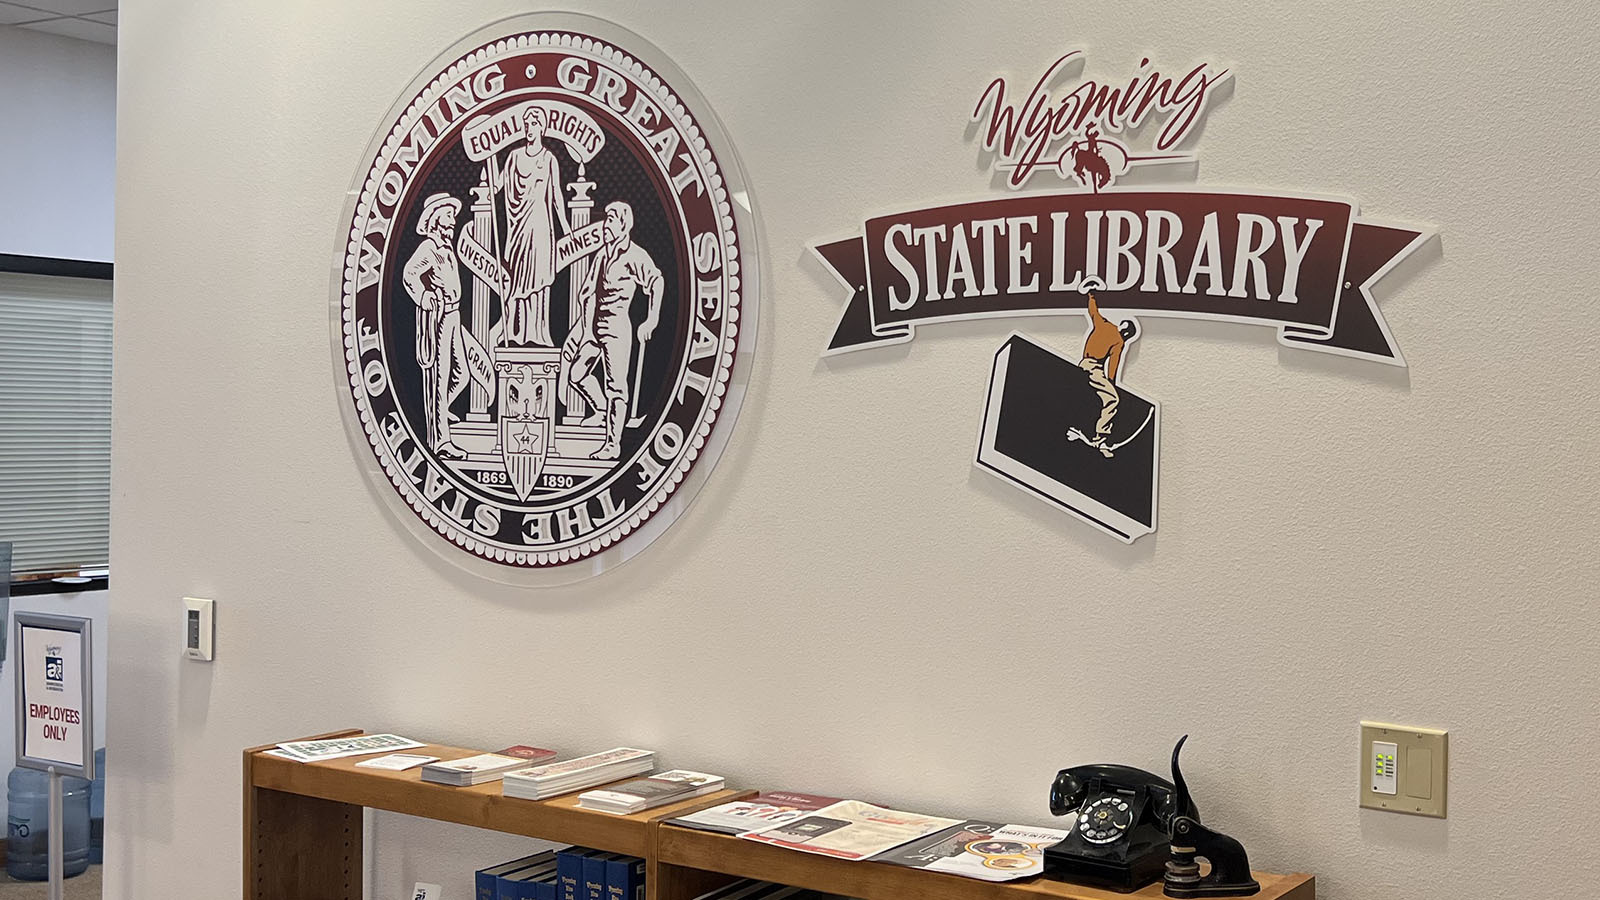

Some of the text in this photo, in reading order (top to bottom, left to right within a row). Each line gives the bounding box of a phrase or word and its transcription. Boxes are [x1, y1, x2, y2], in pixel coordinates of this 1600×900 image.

[974, 50, 1229, 183] Wyoming
[470, 111, 602, 155] EQUAL RIGHTS
[559, 228, 600, 260] MINES
[884, 209, 1324, 311] STATE LIBRARY
[357, 57, 722, 544] GREAT SEAL OF THE STATE OF WYOMING
[468, 346, 491, 383] GRAIN
[520, 436, 530, 444] 44
[476, 471, 507, 483] 1869
[543, 474, 573, 487] 1890
[30, 704, 80, 724] EMPLOYEES
[43, 724, 67, 741] ONLY
